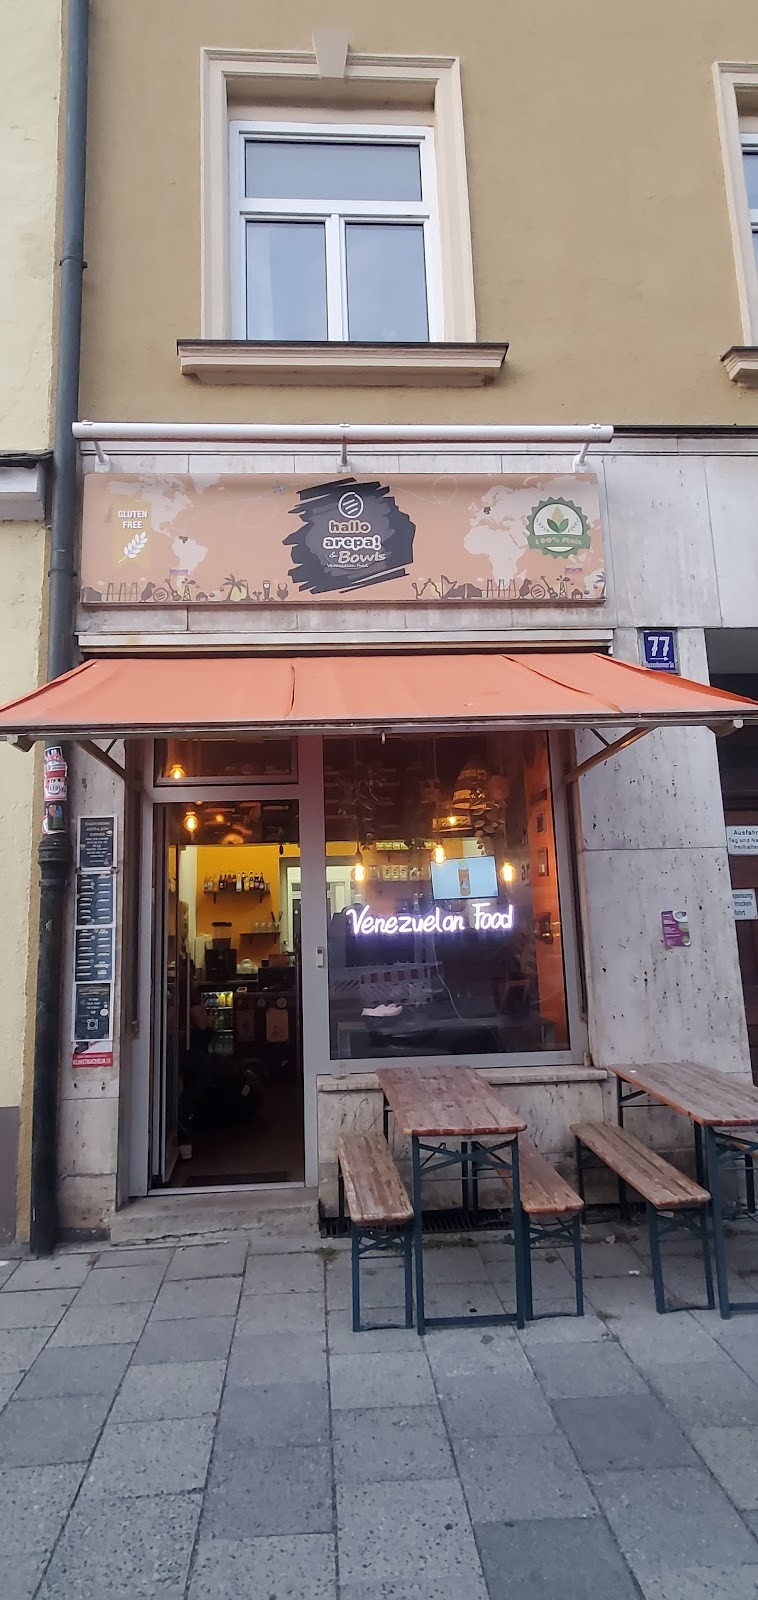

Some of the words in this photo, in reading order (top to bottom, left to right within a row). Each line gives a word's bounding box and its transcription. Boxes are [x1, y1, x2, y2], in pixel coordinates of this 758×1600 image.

[117, 510, 148, 518] GLUTEN
[122, 520, 143, 529] FREE
[329, 520, 371, 534] hallo
[323, 535, 381, 551] arepa!
[338, 550, 386, 564] Bowls
[647, 636, 670, 657] 77
[346, 904, 465, 935] Venezuelan
[472, 902, 514, 931] Food
